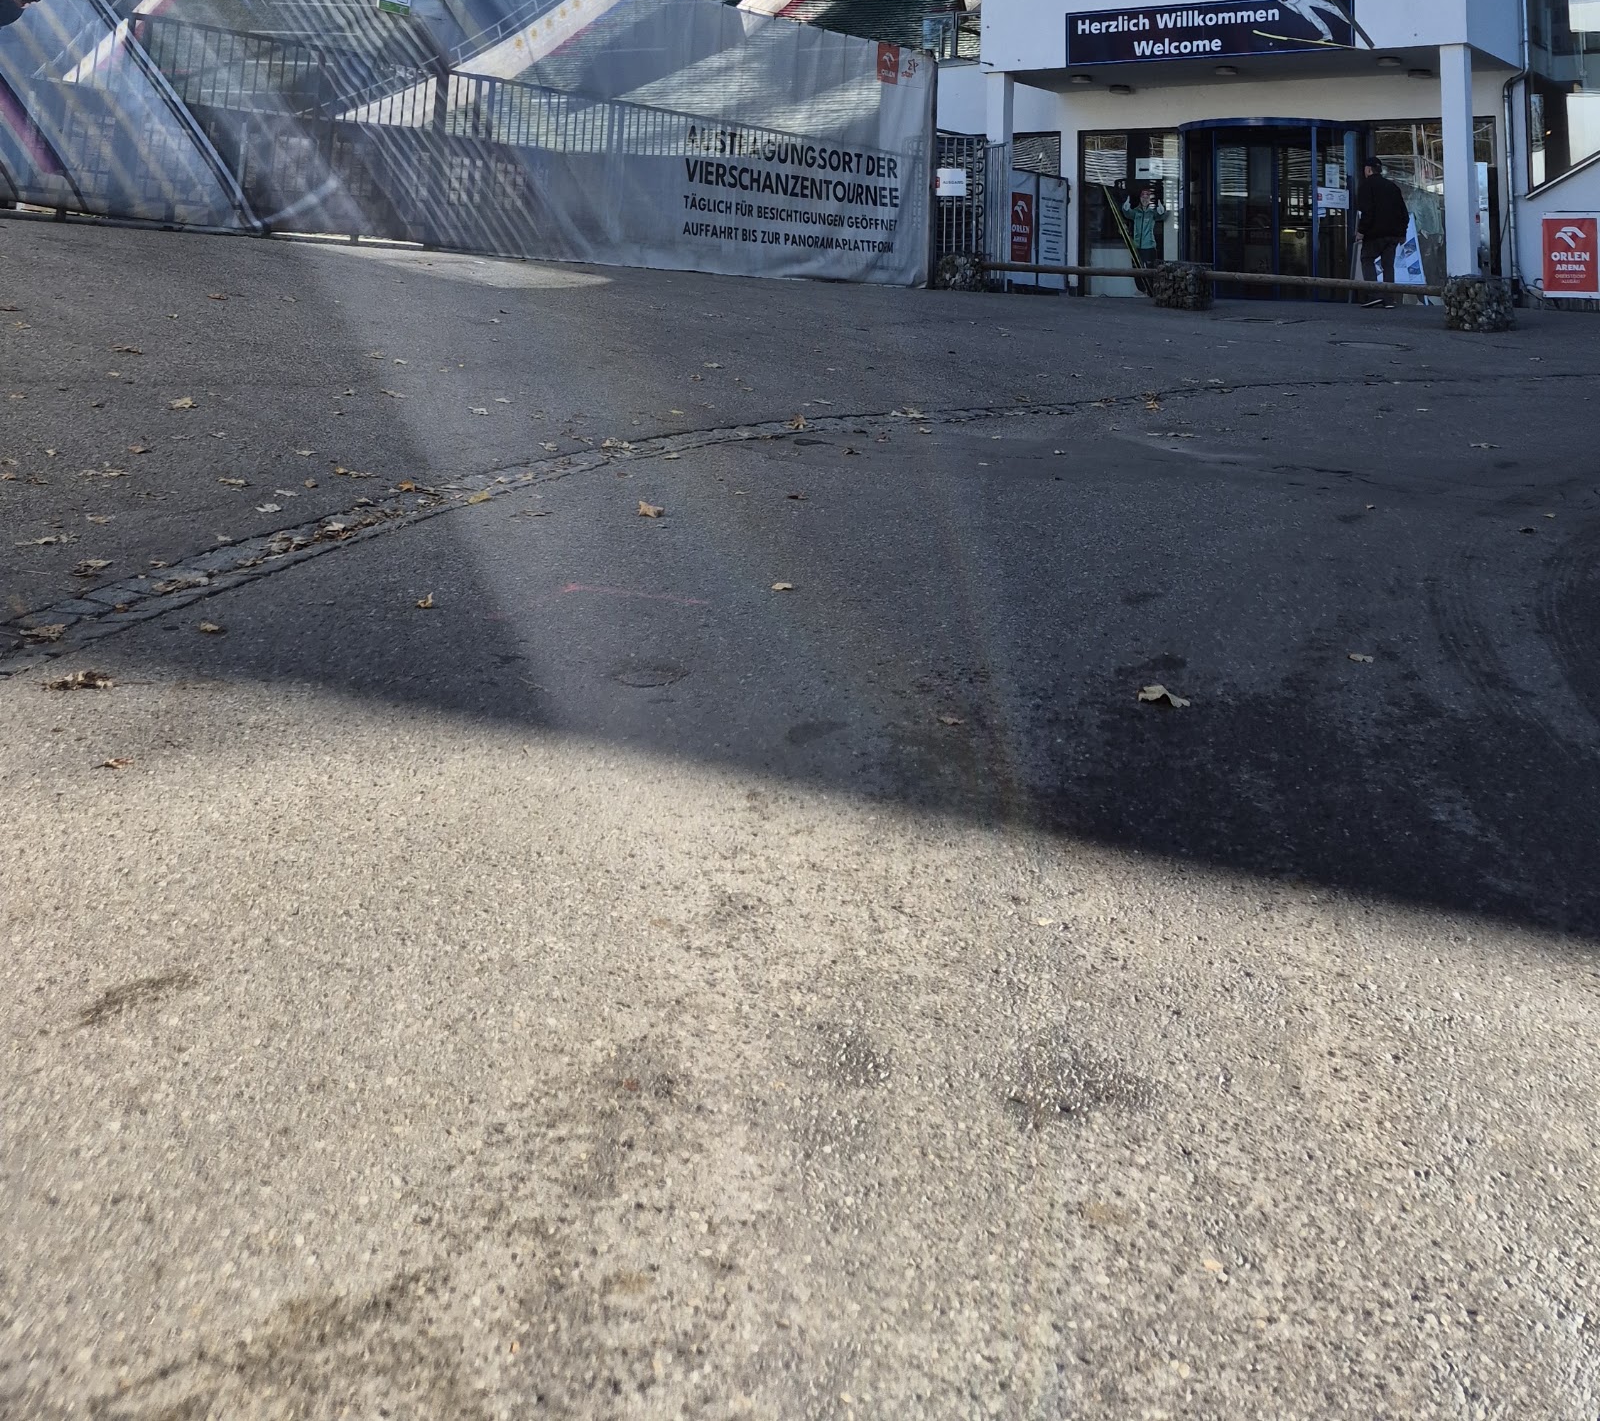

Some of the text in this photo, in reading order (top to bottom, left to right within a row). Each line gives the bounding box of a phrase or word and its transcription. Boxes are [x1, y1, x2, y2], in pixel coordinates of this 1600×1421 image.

[1077, 7, 1280, 35] Herzlich Willkommen
[1133, 37, 1222, 57] Welcome
[865, 155, 898, 179] DER
[685, 157, 900, 208] VIERSCHANZENTOURNEE
[683, 192, 898, 233] TÄGLICH FÜR BESICHTIGUNGEN GEÖFFNET
[682, 221, 894, 254] AUFFAHRT BIS ZUR PANORAMAPLATTFORM
[1011, 223, 1030, 234] ORLEN
[1551, 251, 1590, 261] ORLEN
